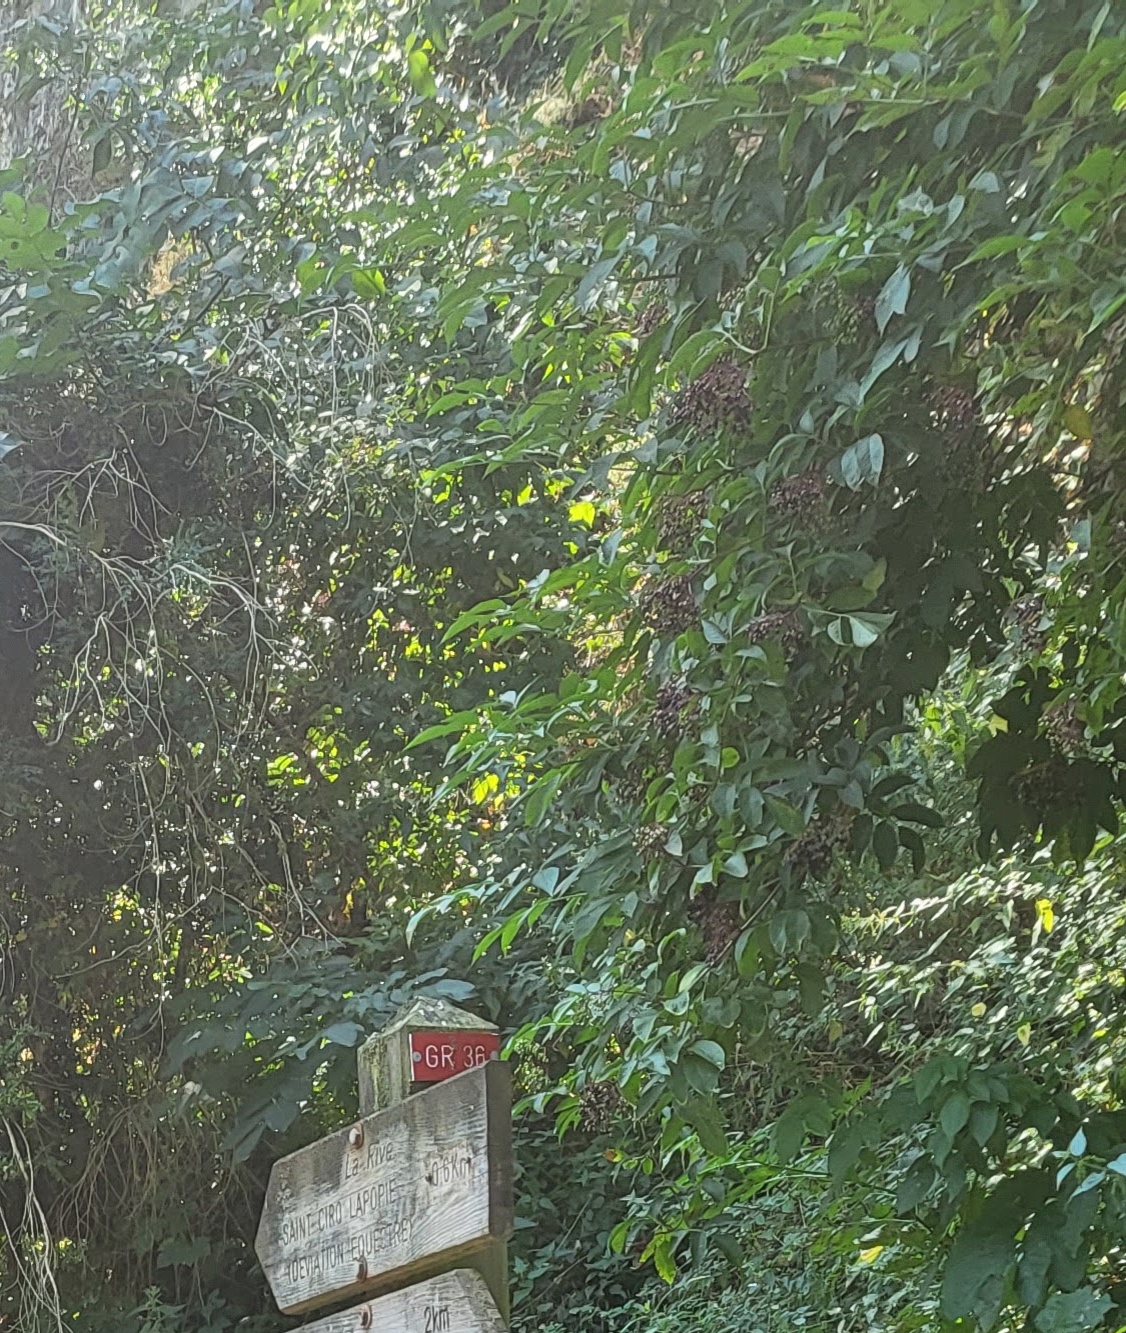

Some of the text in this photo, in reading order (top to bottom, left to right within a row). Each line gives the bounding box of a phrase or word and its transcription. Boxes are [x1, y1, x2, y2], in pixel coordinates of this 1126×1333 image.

[425, 1044, 486, 1068] GR 36
[344, 1141, 393, 1181] La Rive
[349, 1177, 398, 1220] LAPOPIE
